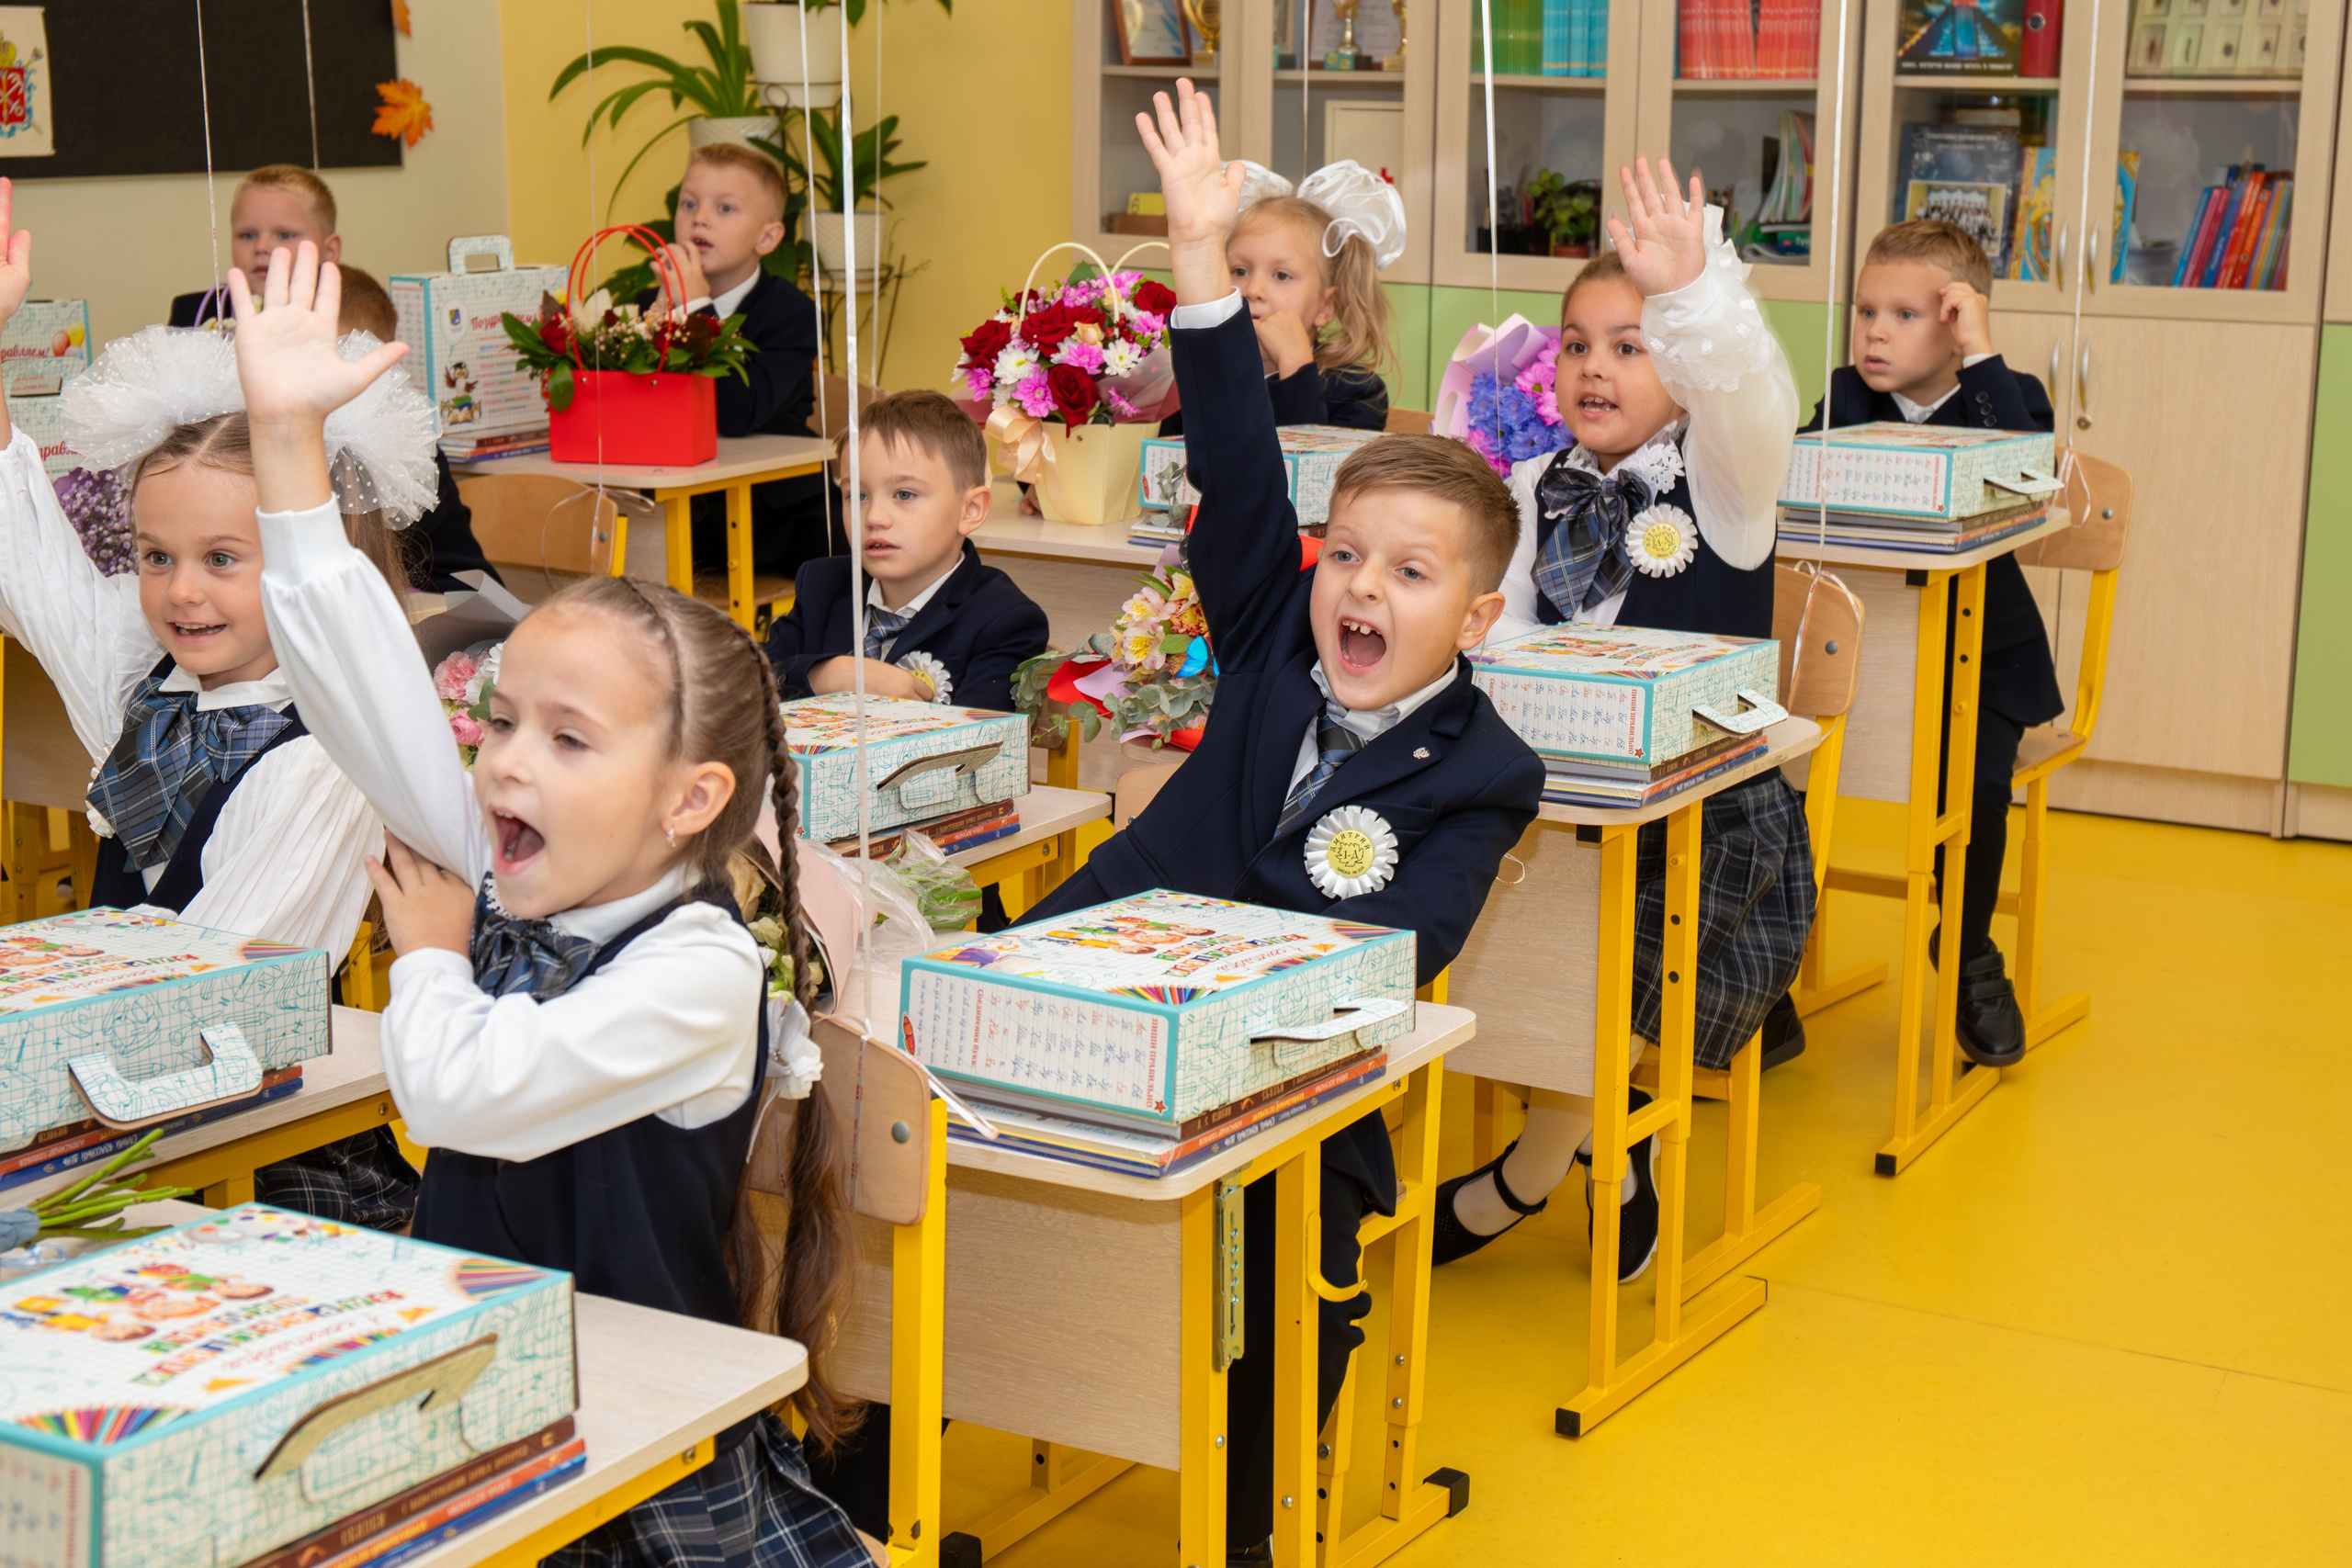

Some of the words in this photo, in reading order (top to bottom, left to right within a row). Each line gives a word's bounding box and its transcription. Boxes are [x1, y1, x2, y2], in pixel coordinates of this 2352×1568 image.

[1342, 850, 1359, 861] 1-Д
[974, 988, 983, 1043] Соединения
[1149, 1018, 1159, 1048] ПИШИ
[970, 1043, 979, 1067] букв:
[1147, 1051, 1157, 1108] ПРАВИЛЬНО
[48, 1139, 85, 1157] АЛЕКСАНДР
[81, 1139, 114, 1162] КЛАССНЫЙ
[116, 1134, 139, 1150] САМЫЙ
[62, 1155, 79, 1167] ДЕНЬ
